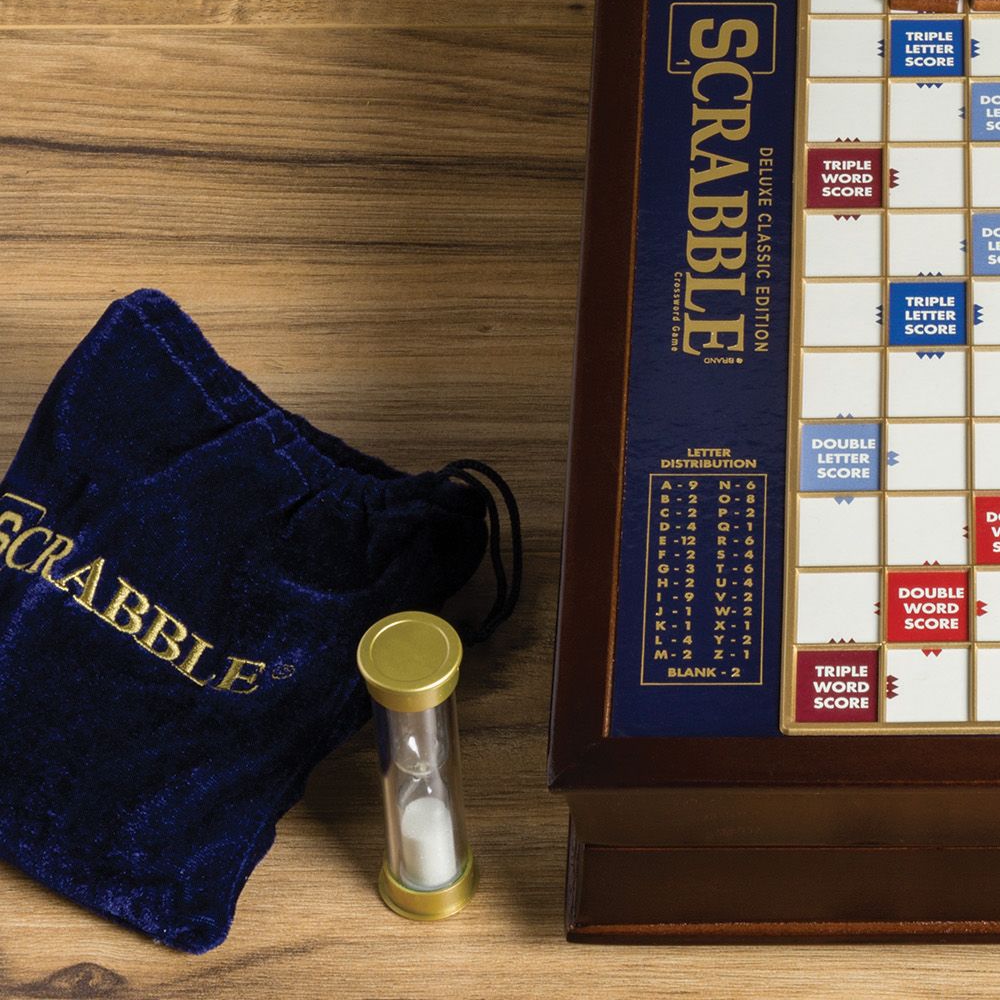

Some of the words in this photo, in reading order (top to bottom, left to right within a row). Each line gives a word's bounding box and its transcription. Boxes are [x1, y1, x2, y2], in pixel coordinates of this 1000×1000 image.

[757, 147, 774, 207] DELUXE
[682, 18, 759, 356] SCRABBLE
[756, 213, 773, 279] CLASSIC
[672, 272, 683, 320] Crossword
[904, 296, 955, 307] TRIPLE
[753, 286, 772, 353] EDITION
[904, 309, 956, 320] LETTER
[904, 323, 956, 335] SCORE
[670, 323, 680, 352] Game
[811, 438, 876, 449] DOUBLE
[687, 448, 731, 458] LETTER
[816, 452, 870, 464] LETTER
[660, 459, 757, 469] DISTRIBUTION
[816, 467, 870, 478] SCORE
[668, 668, 716, 678] BLANK
[814, 665, 868, 677] TRIPLE
[812, 680, 870, 693] WORD
[813, 696, 869, 709] SCORE
